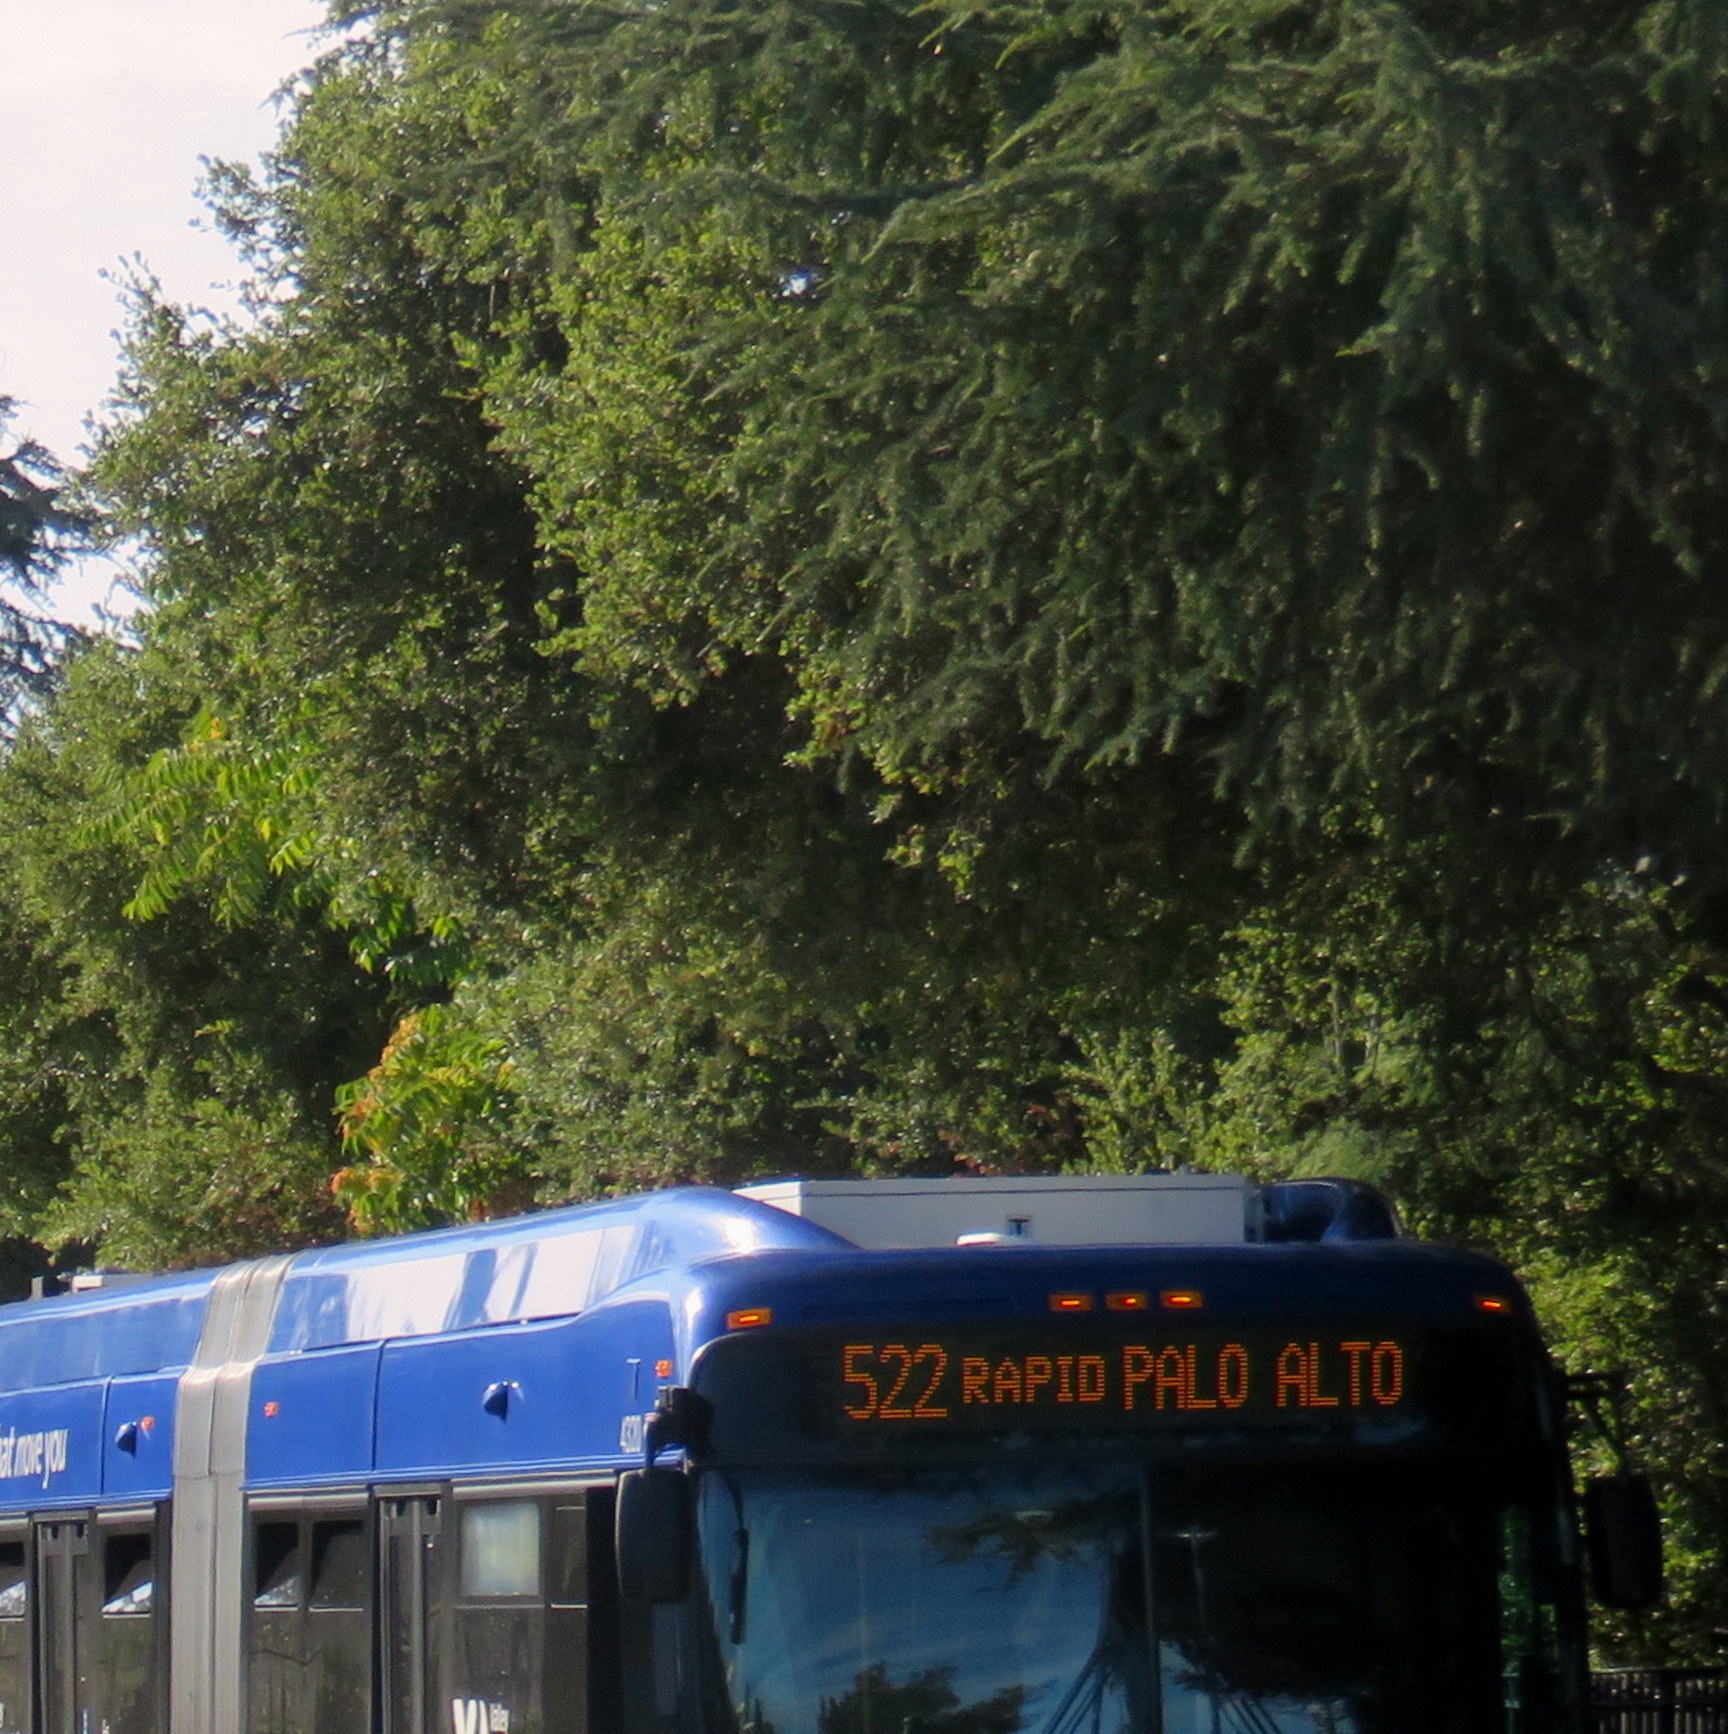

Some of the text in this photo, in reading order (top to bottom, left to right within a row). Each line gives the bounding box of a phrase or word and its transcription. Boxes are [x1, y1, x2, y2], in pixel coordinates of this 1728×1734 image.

[843, 1341, 1403, 1420] 522 RAPID PALO ALTO
[41, 1428, 69, 1489] you
